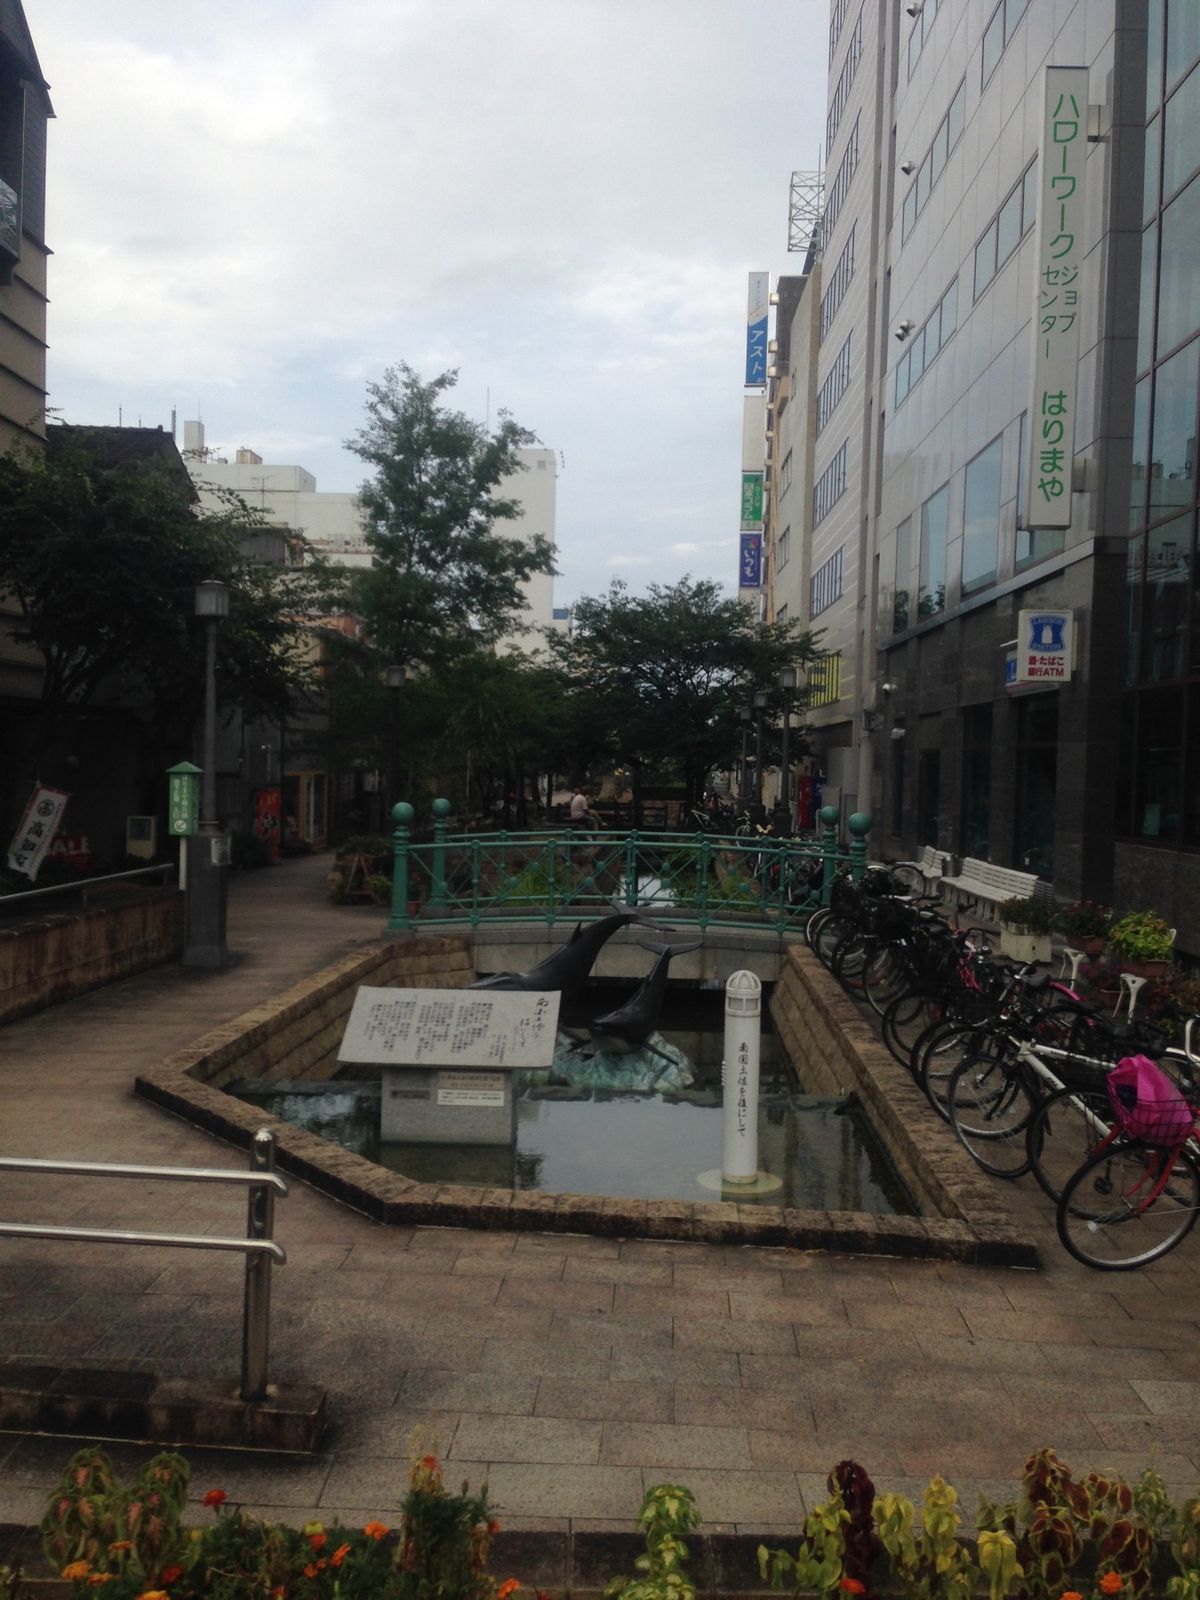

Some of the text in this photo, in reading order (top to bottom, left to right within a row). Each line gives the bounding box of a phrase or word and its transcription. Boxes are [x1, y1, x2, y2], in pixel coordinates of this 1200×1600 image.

[1050, 93, 1080, 259] ハローワーク
[1041, 265, 1060, 358] センター
[1058, 266, 1080, 333] ジョブ
[750, 330, 764, 375] アスト
[1038, 391, 1067, 502] はりまや
